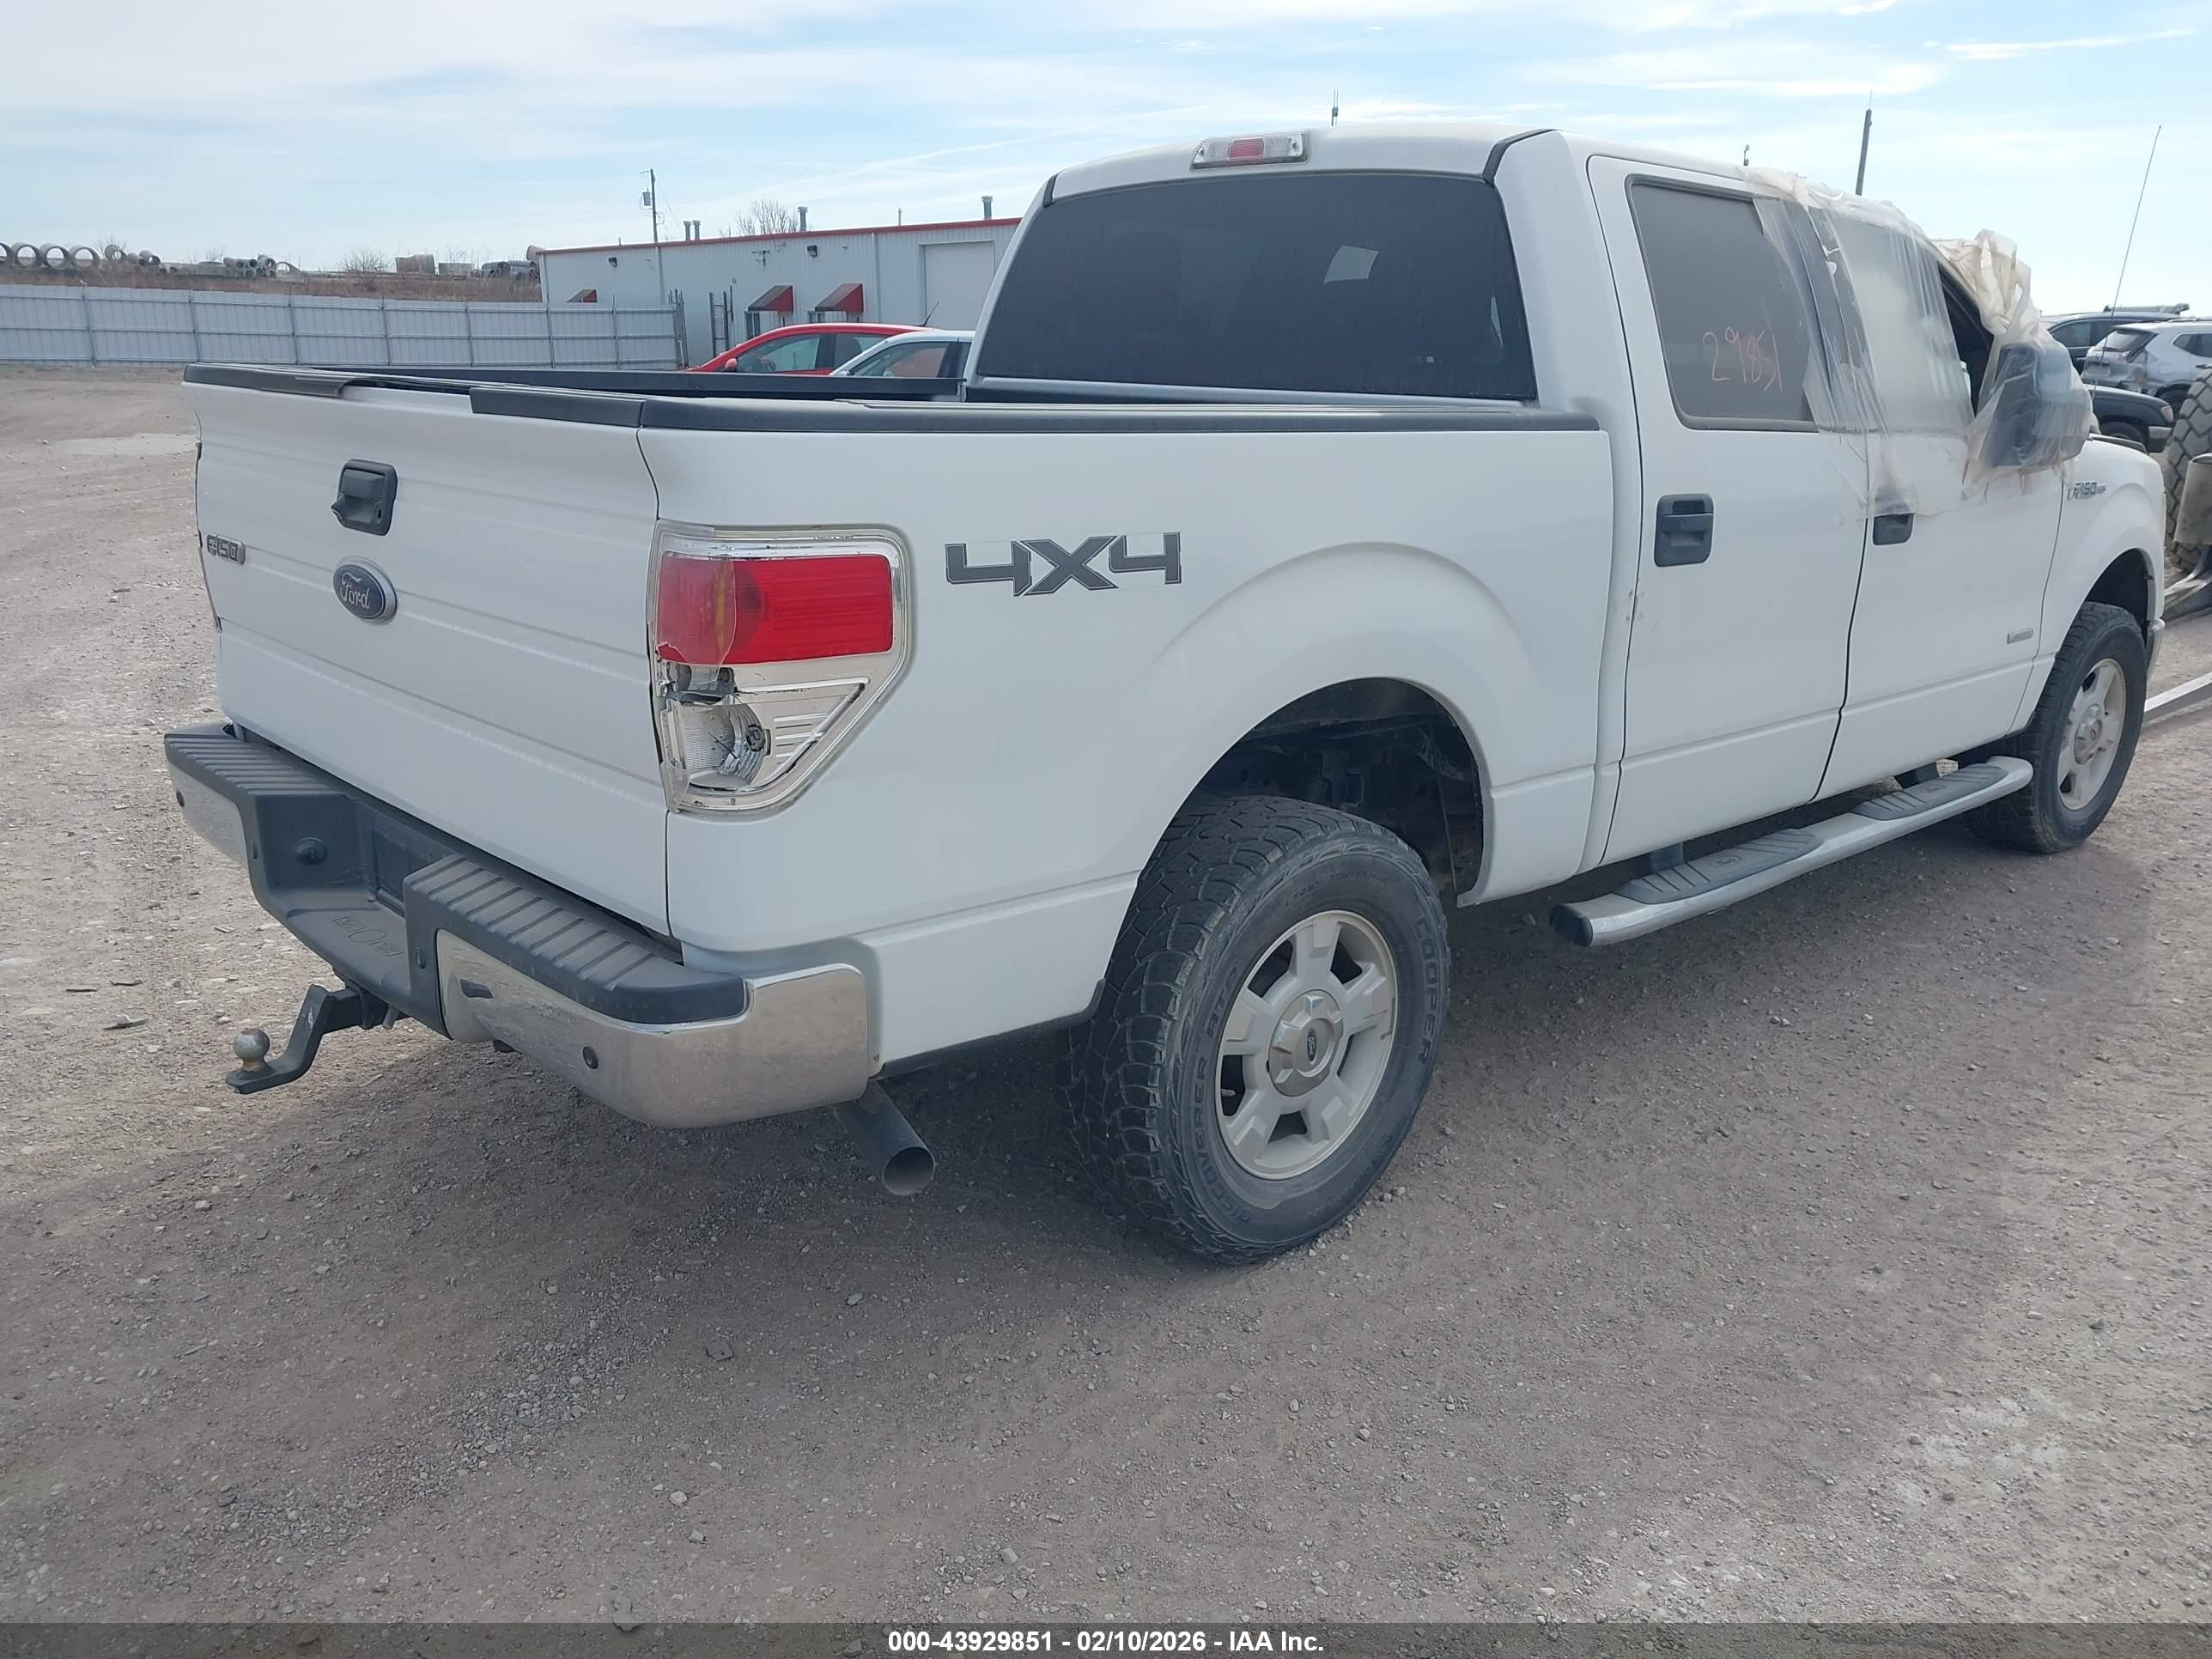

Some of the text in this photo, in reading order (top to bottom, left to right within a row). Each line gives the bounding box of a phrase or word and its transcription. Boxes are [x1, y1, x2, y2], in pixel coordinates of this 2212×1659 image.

[1702, 326, 1784, 392] 29851
[340, 570, 371, 610] Ford
[945, 532, 1182, 597] 4X4
[1413, 916, 1438, 1066] COOPER
